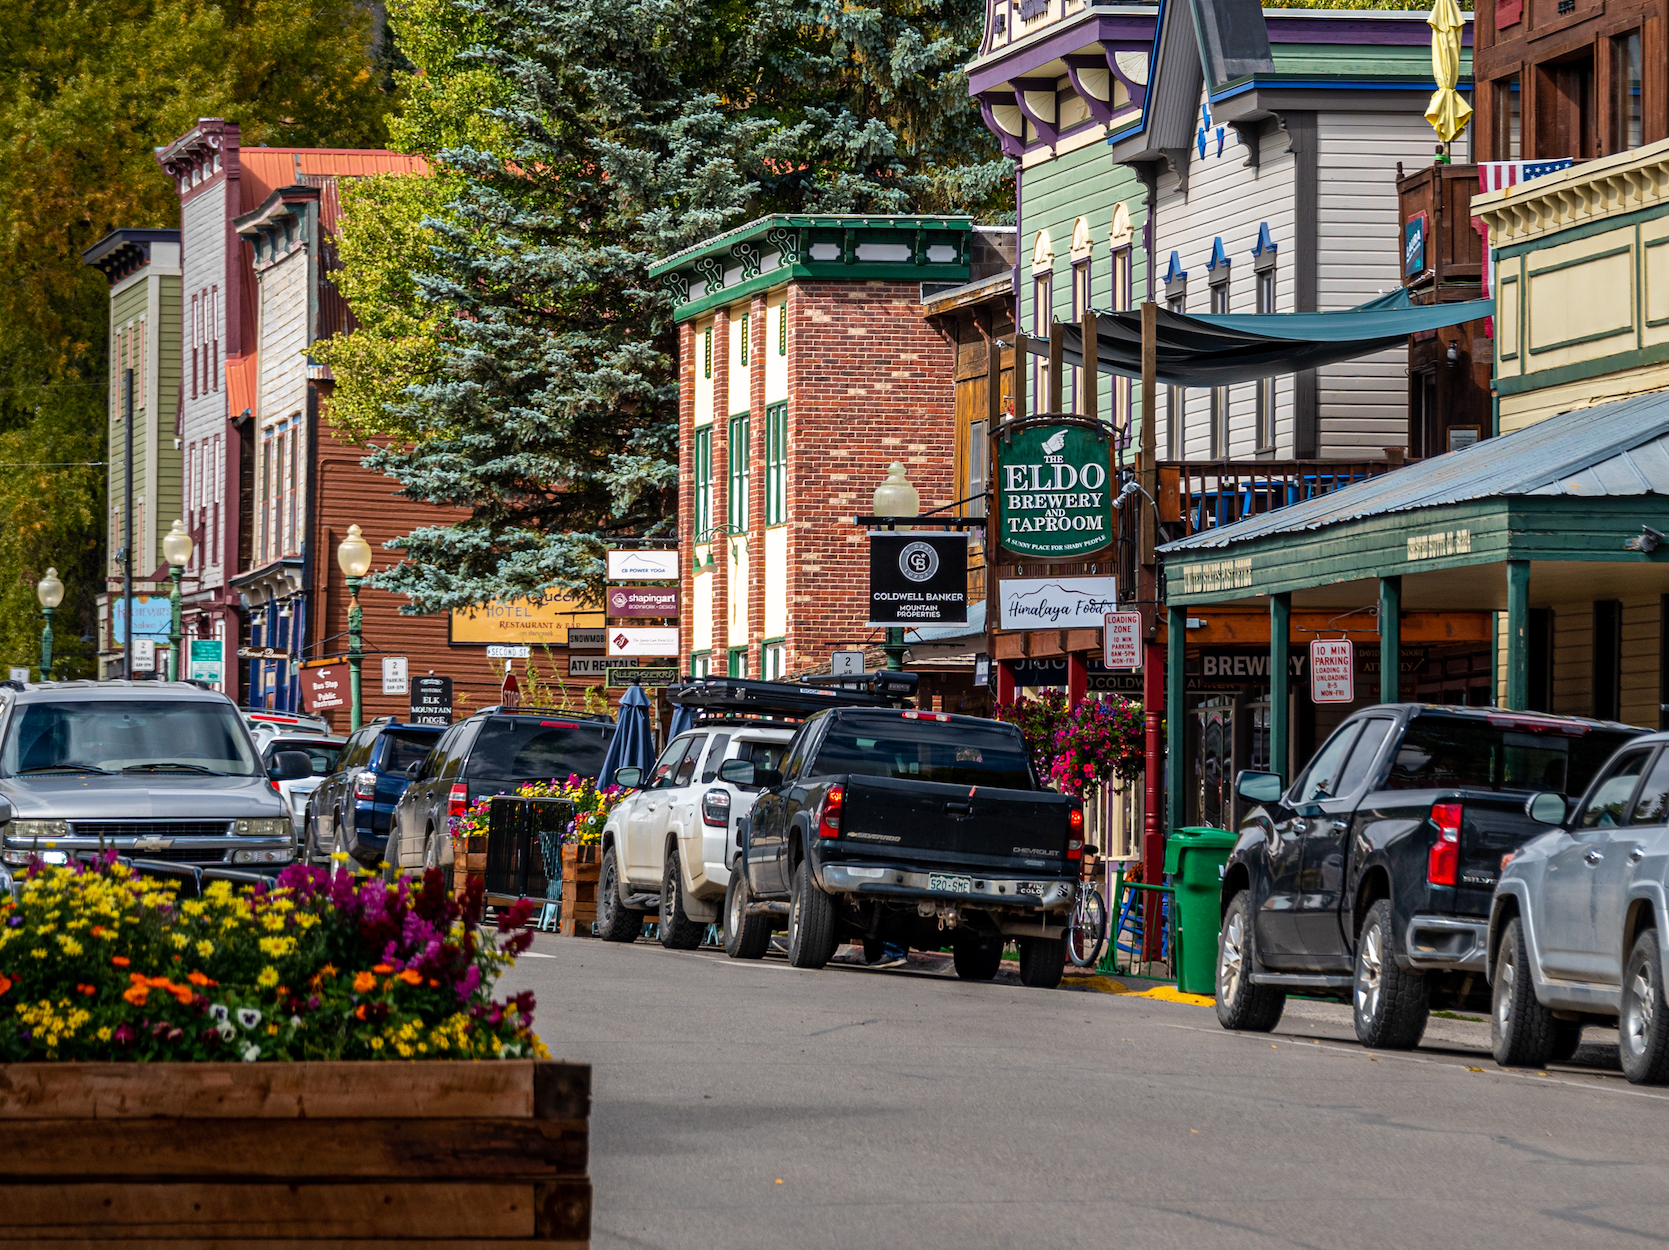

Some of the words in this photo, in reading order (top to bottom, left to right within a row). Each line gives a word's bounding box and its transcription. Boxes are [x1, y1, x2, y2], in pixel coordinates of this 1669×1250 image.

[1044, 455, 1064, 463] THE
[1003, 463, 1106, 491] ELDO
[1008, 493, 1103, 509] BREWERY
[1045, 509, 1066, 517] AND
[1008, 515, 1103, 532] TAPROOM
[1011, 539, 1031, 549] SUNNY
[1064, 542, 1083, 550] SHADY
[1083, 534, 1106, 546] PEOPLE
[628, 594, 676, 604] shapingart
[873, 592, 925, 601] COLDWELL
[926, 593, 964, 601] BANKER
[487, 605, 532, 618] HOTEL
[1008, 599, 1072, 622] Himalaya
[499, 621, 554, 629] RESTAURANT
[1107, 616, 1137, 624] LOADING
[238, 647, 263, 658] Forest
[263, 648, 288, 659] Queen
[491, 648, 516, 656] SECOND
[520, 648, 527, 656] ST
[1316, 646, 1326, 655] 10
[1331, 646, 1346, 655] MIN
[1359, 649, 1380, 657] DAVID
[393, 661, 398, 669] 2
[571, 660, 589, 671] ATV
[592, 660, 637, 671] RENTALS
[845, 657, 851, 667] 2
[1204, 655, 1305, 676] BREWY
[1315, 656, 1349, 666] PARKING
[1363, 662, 1414, 672] ATTEY
[312, 682, 323, 690] Bus
[325, 681, 338, 689] Stop
[317, 692, 336, 701] Public
[423, 696, 440, 704] ELK
[504, 690, 519, 706] STOP
[312, 698, 343, 708] Restrooms
[411, 706, 452, 714] MOUNTAIN
[856, 832, 901, 842] SILVERADO
[1013, 847, 1060, 856] CHEVROLET
